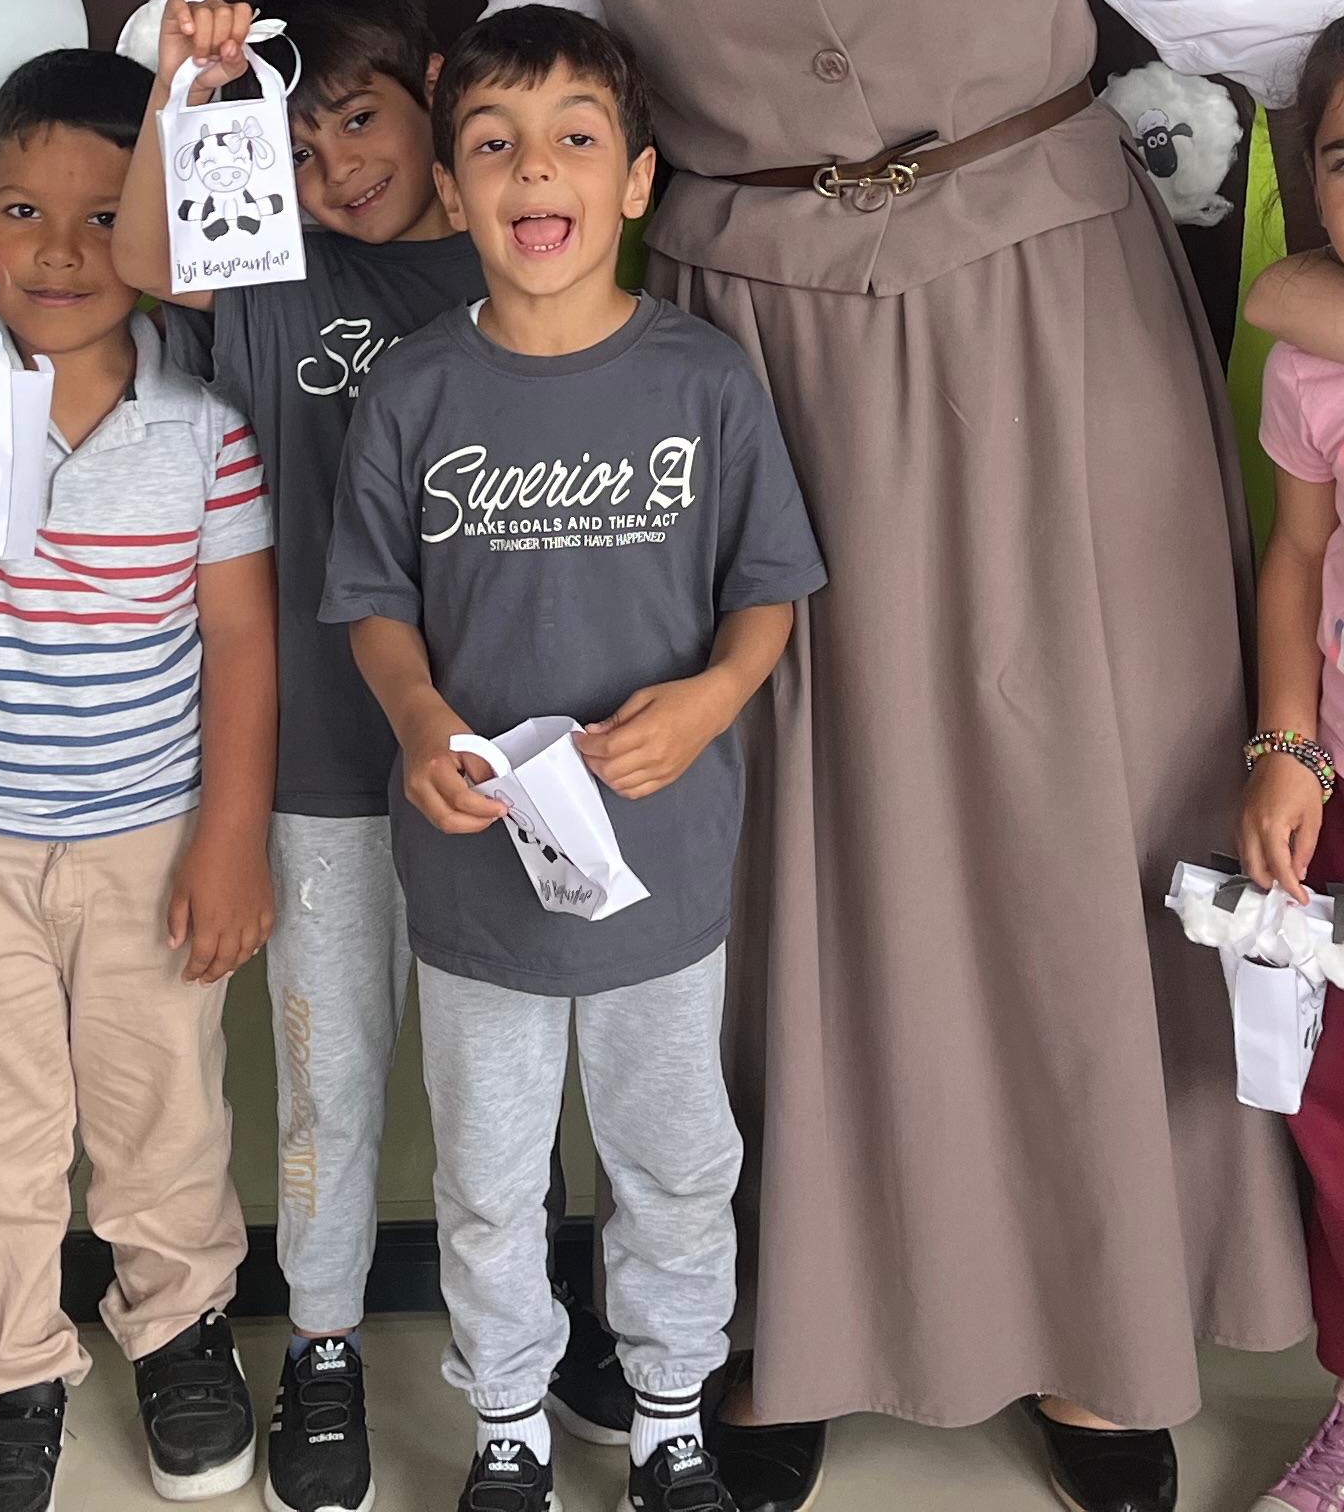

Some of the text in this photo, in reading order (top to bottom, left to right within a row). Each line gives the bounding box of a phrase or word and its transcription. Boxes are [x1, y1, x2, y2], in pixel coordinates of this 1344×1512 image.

[420, 444, 634, 544] Superior
[464, 512, 679, 537] MAKE GOALS AND THEN ACT
[489, 531, 666, 552] STRANGER THINGS HAVE HAPPENED
[308, 1432, 345, 1444] adidas
